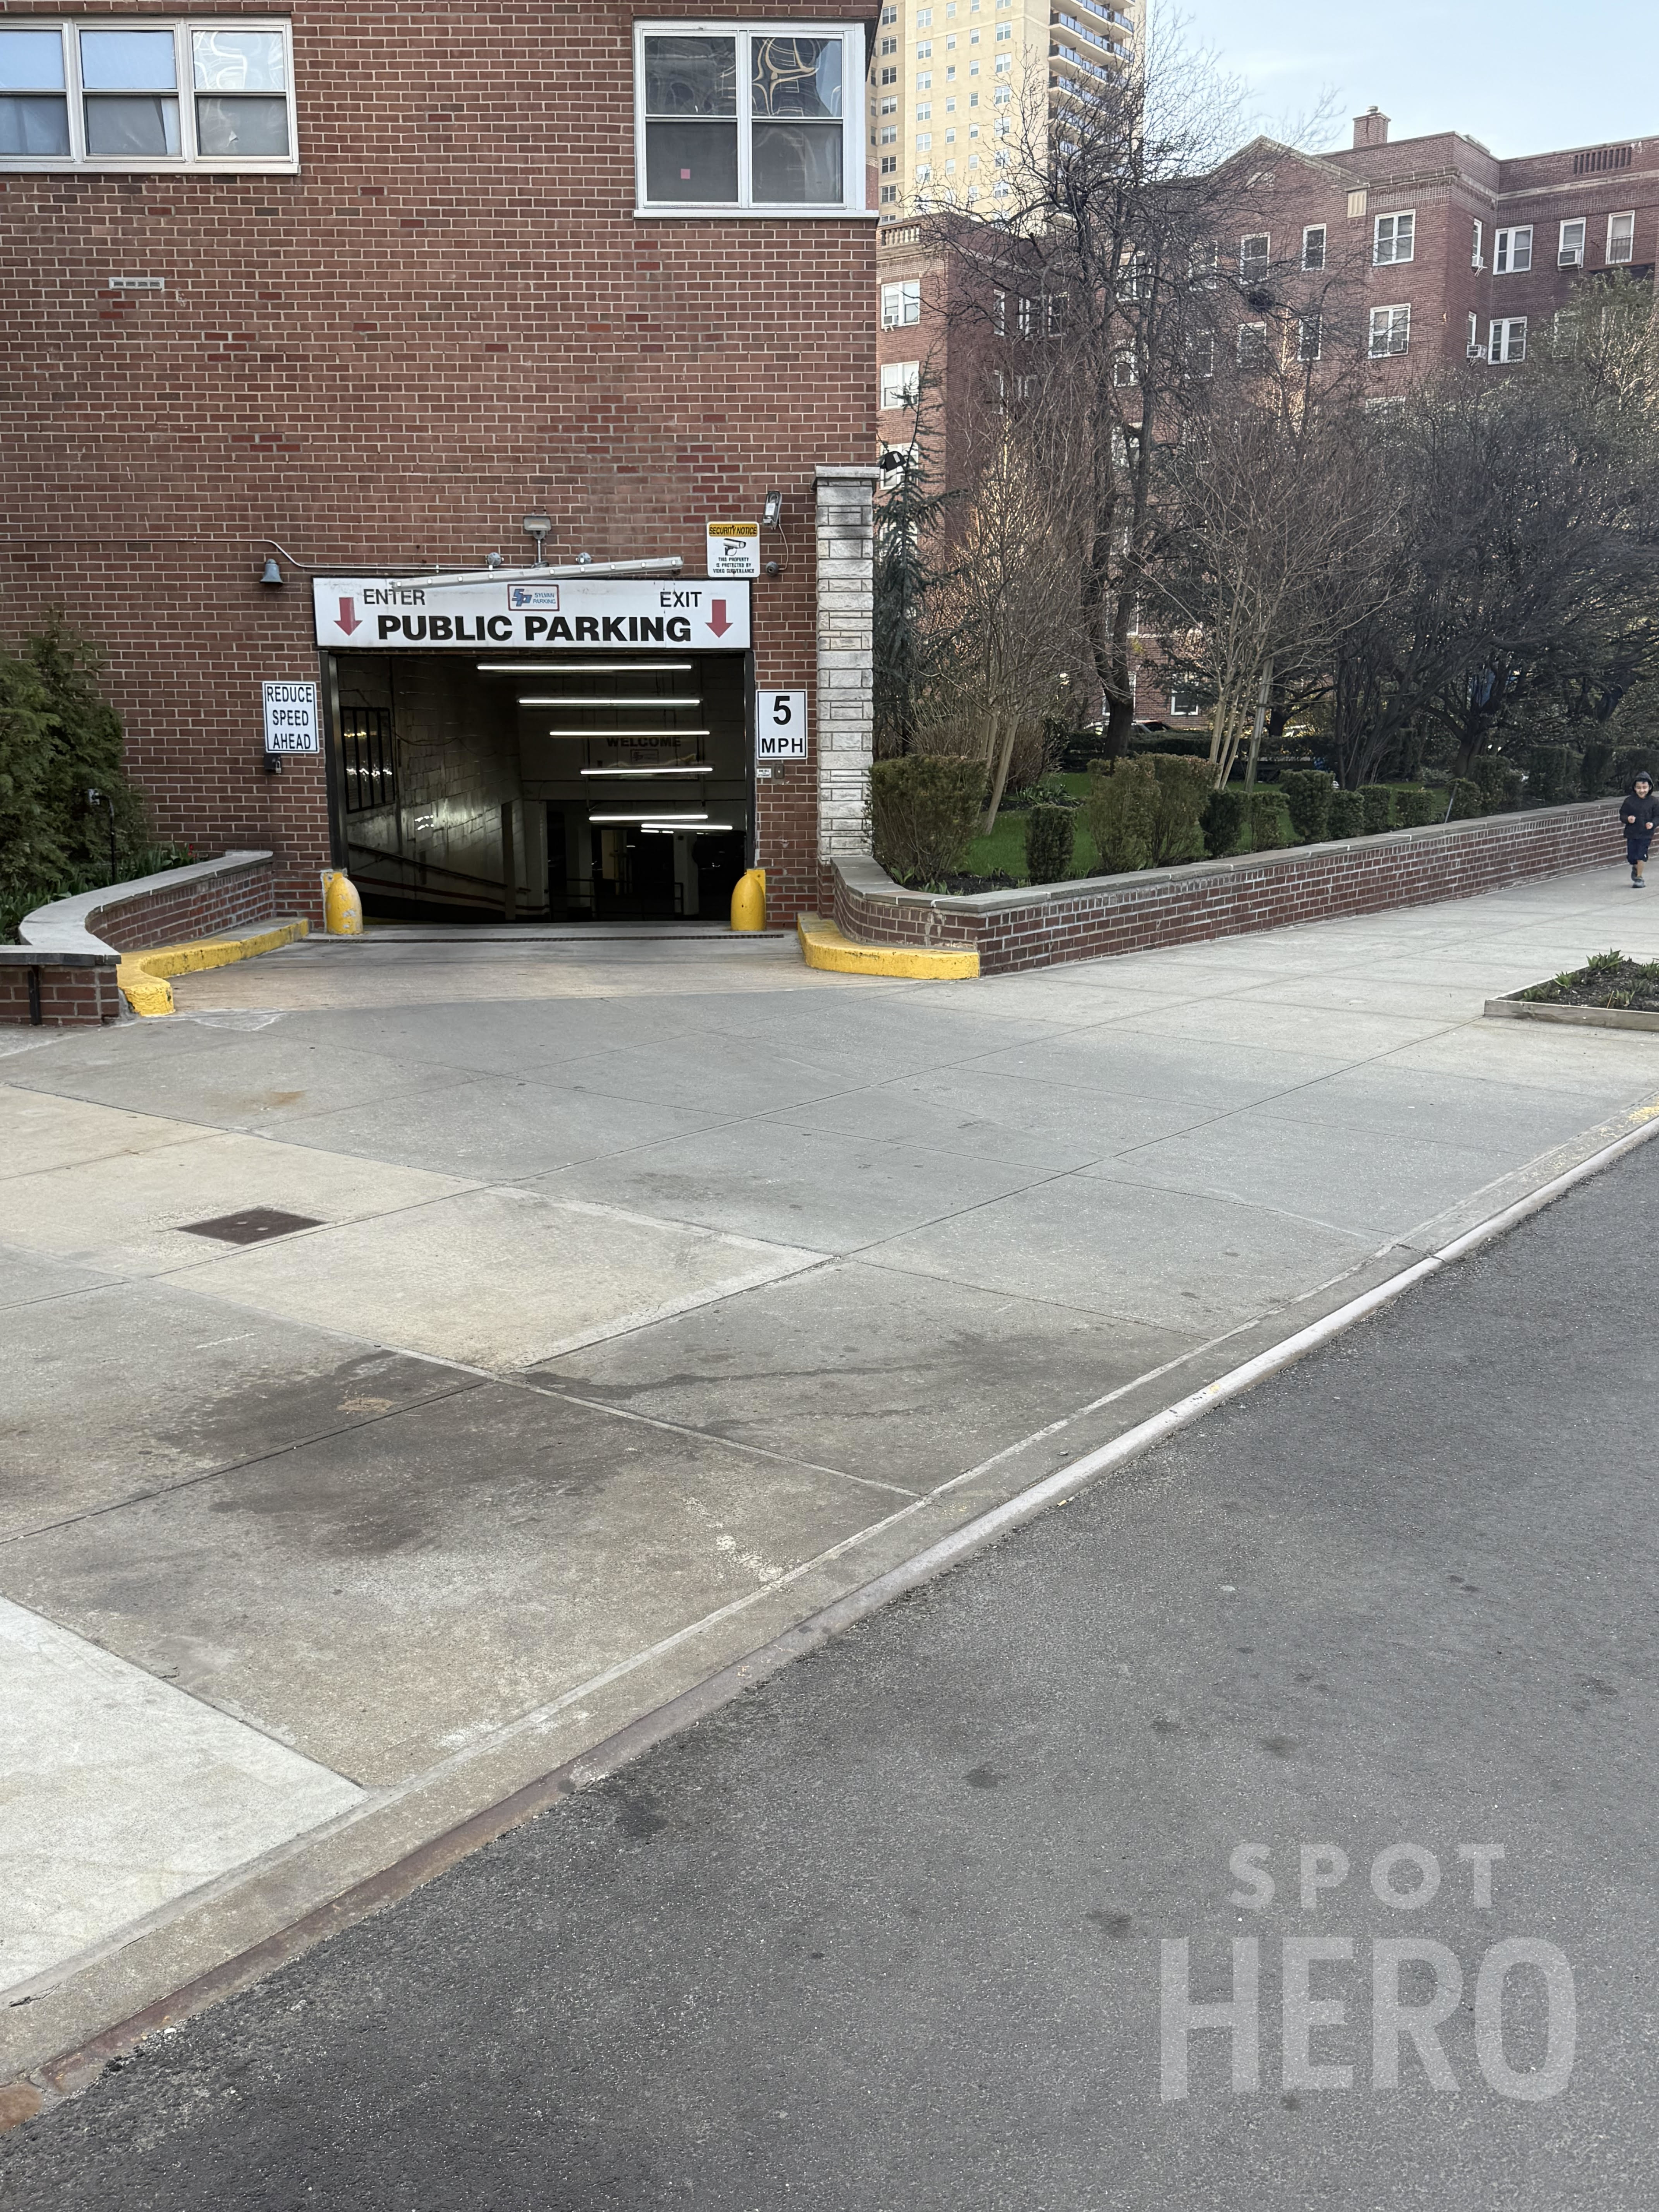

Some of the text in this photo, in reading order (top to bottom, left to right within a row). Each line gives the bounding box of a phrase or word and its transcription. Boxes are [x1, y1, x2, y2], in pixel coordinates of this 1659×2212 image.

[363, 588, 425, 605] ENTER
[660, 591, 702, 607] EXIT
[378, 615, 691, 642] PUBLIC PARKING
[267, 686, 312, 702] REDUCE
[273, 710, 308, 726] SPEED
[773, 696, 791, 725] 5
[273, 734, 311, 749] AHEAD
[607, 737, 681, 747] WELCOME
[762, 738, 803, 753] MPH
